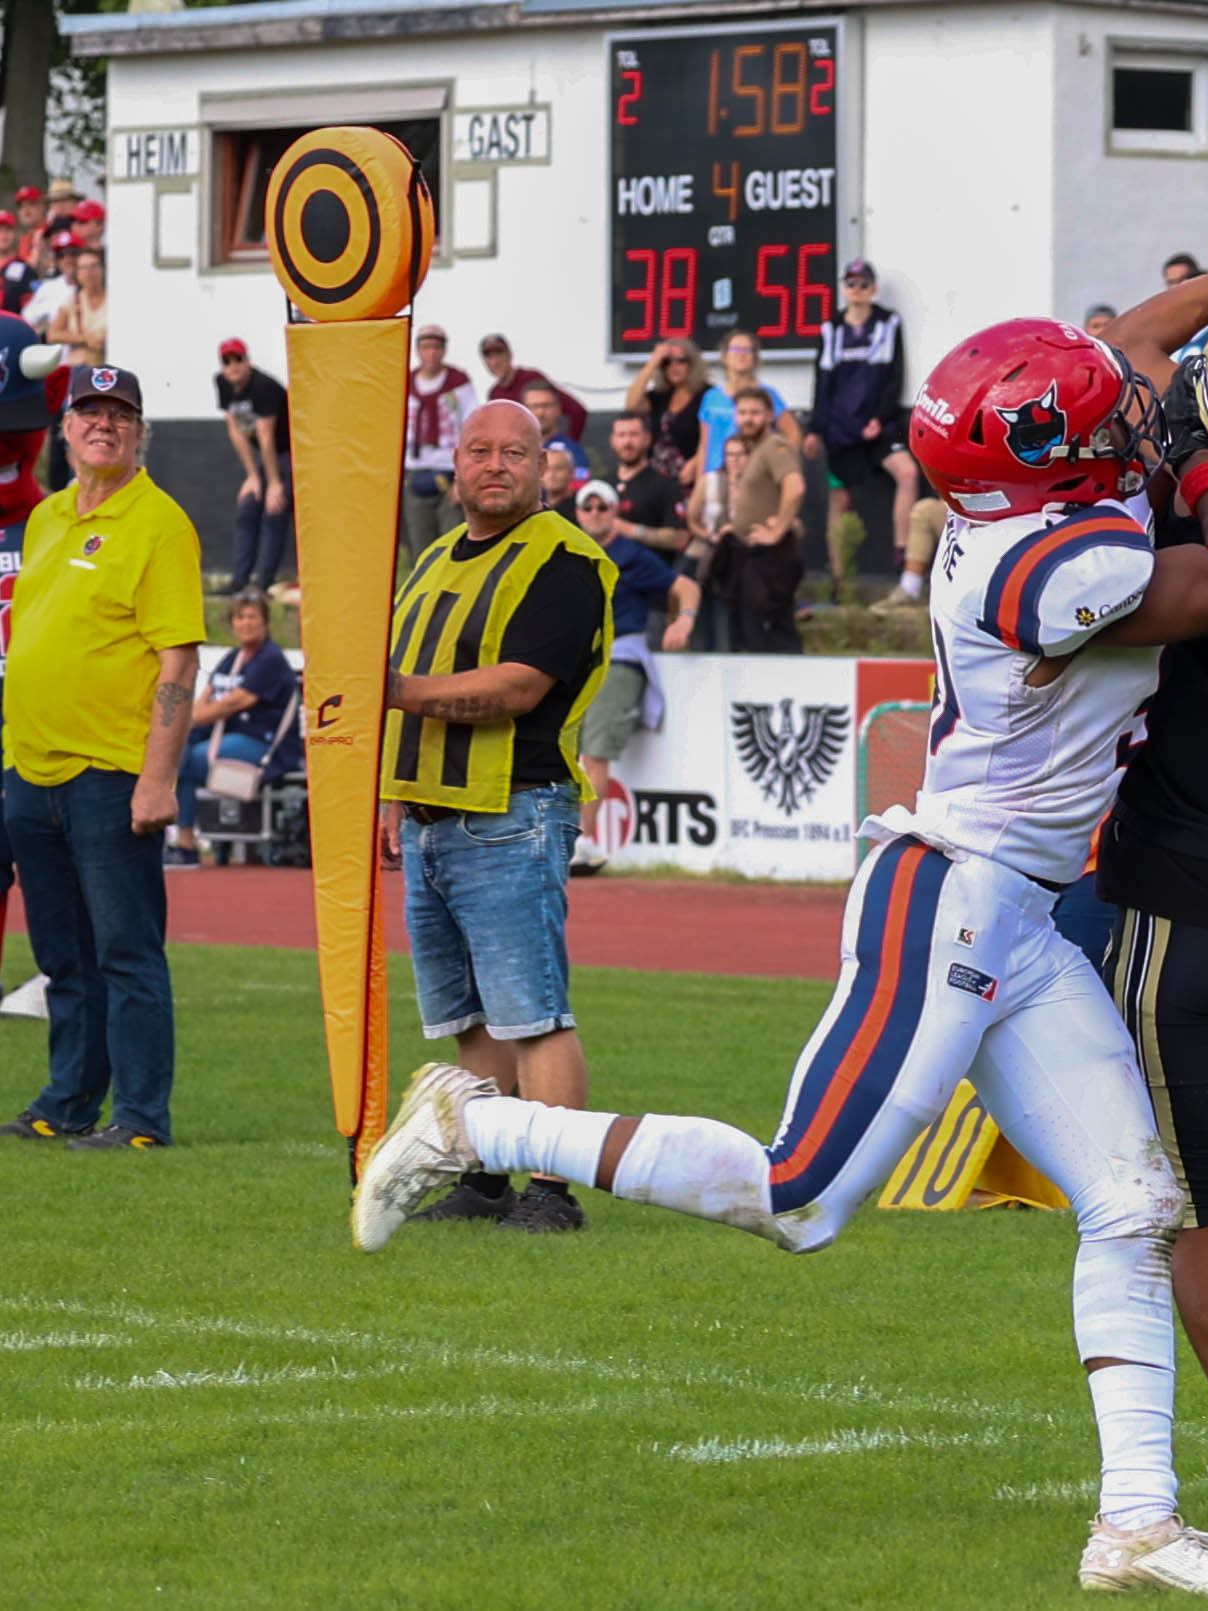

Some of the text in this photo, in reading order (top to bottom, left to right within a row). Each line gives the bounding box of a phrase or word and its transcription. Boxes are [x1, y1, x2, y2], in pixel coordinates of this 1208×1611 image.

[617, 71, 643, 125] 2
[810, 59, 835, 115] 2
[127, 136, 188, 177] HEIM
[468, 114, 535, 159] GAST
[617, 174, 694, 215] HOME
[712, 162, 740, 221] 4
[745, 168, 835, 210] GUEST
[621, 248, 698, 340] 38
[755, 243, 832, 337] 56
